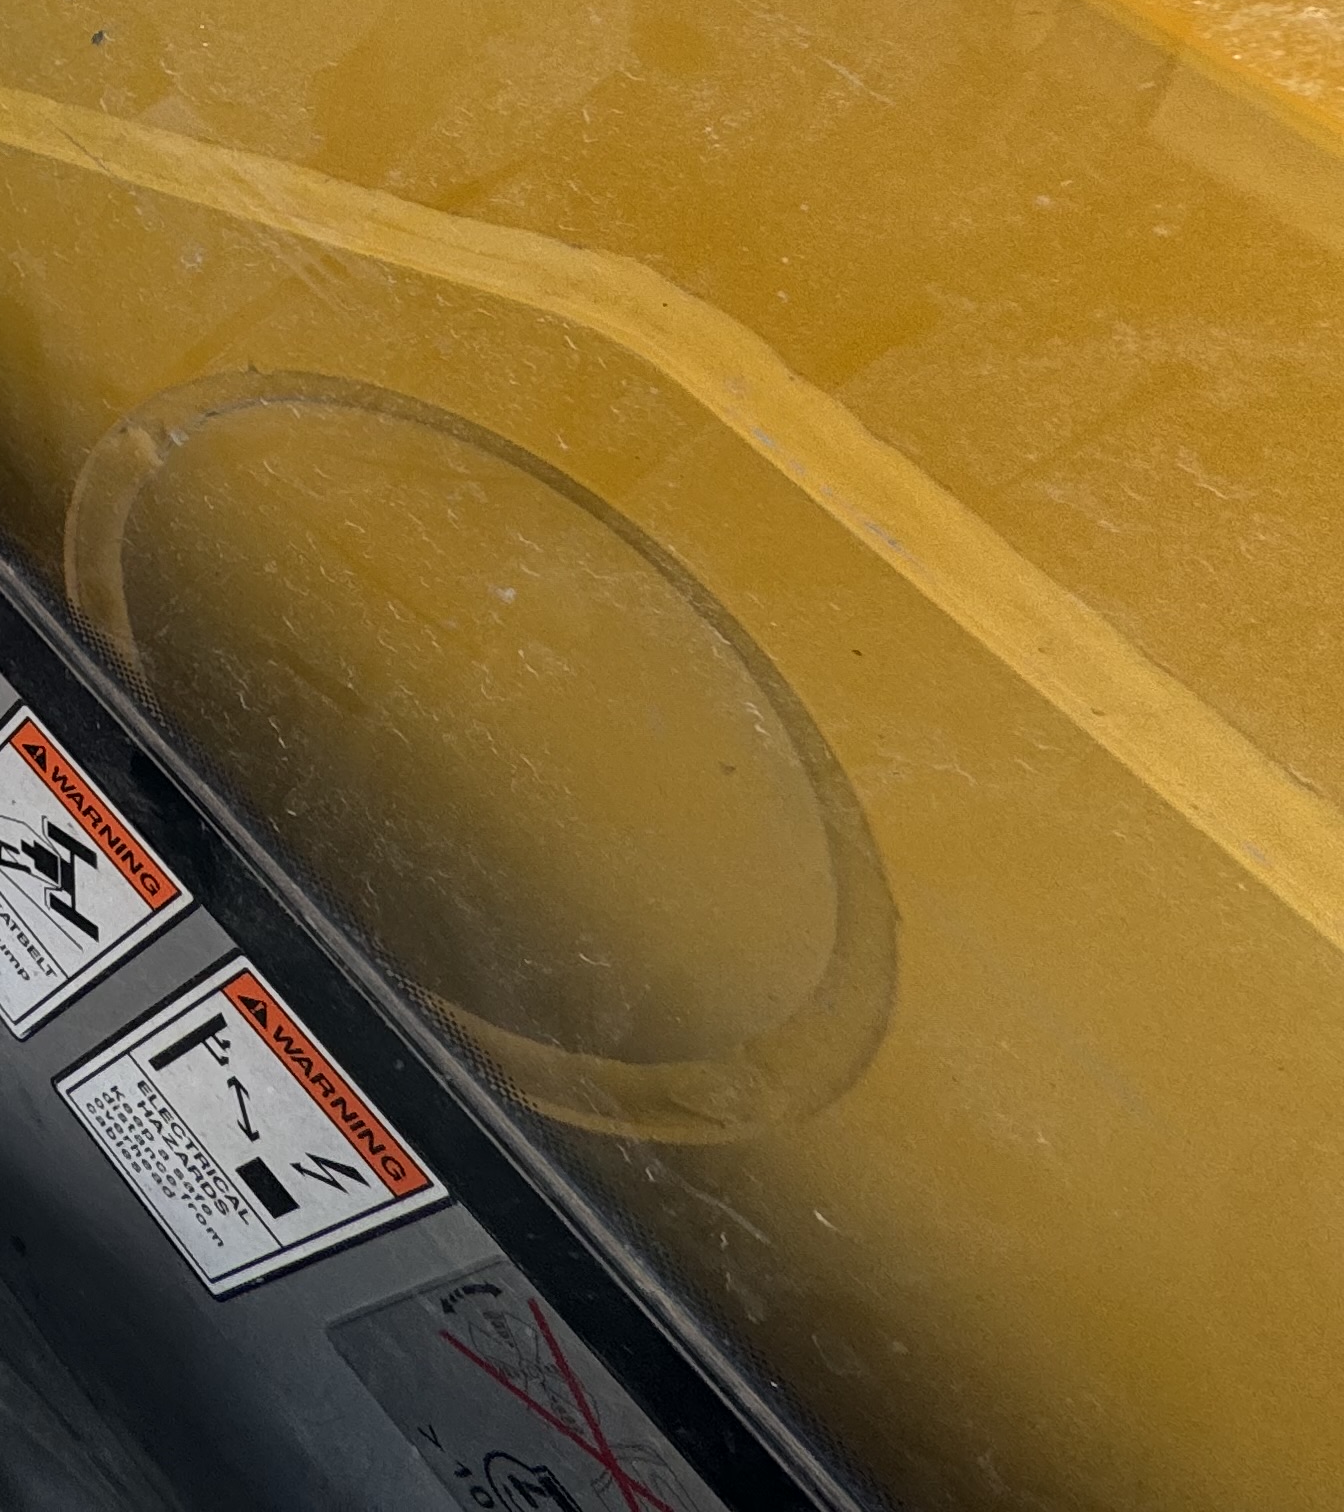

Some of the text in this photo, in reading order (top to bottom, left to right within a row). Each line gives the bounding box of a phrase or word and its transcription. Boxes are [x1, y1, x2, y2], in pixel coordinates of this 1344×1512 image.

[51, 765, 161, 897] WARNING
[86, 1103, 142, 1174] cables
[94, 1097, 177, 1198] overhead
[110, 1086, 213, 1216] Keep a safe
[137, 1080, 250, 1225] ELECTRICAL
[137, 1100, 230, 1216] HAZARDS
[273, 1025, 407, 1182] WARNING
[102, 1092, 224, 1247] distance from
